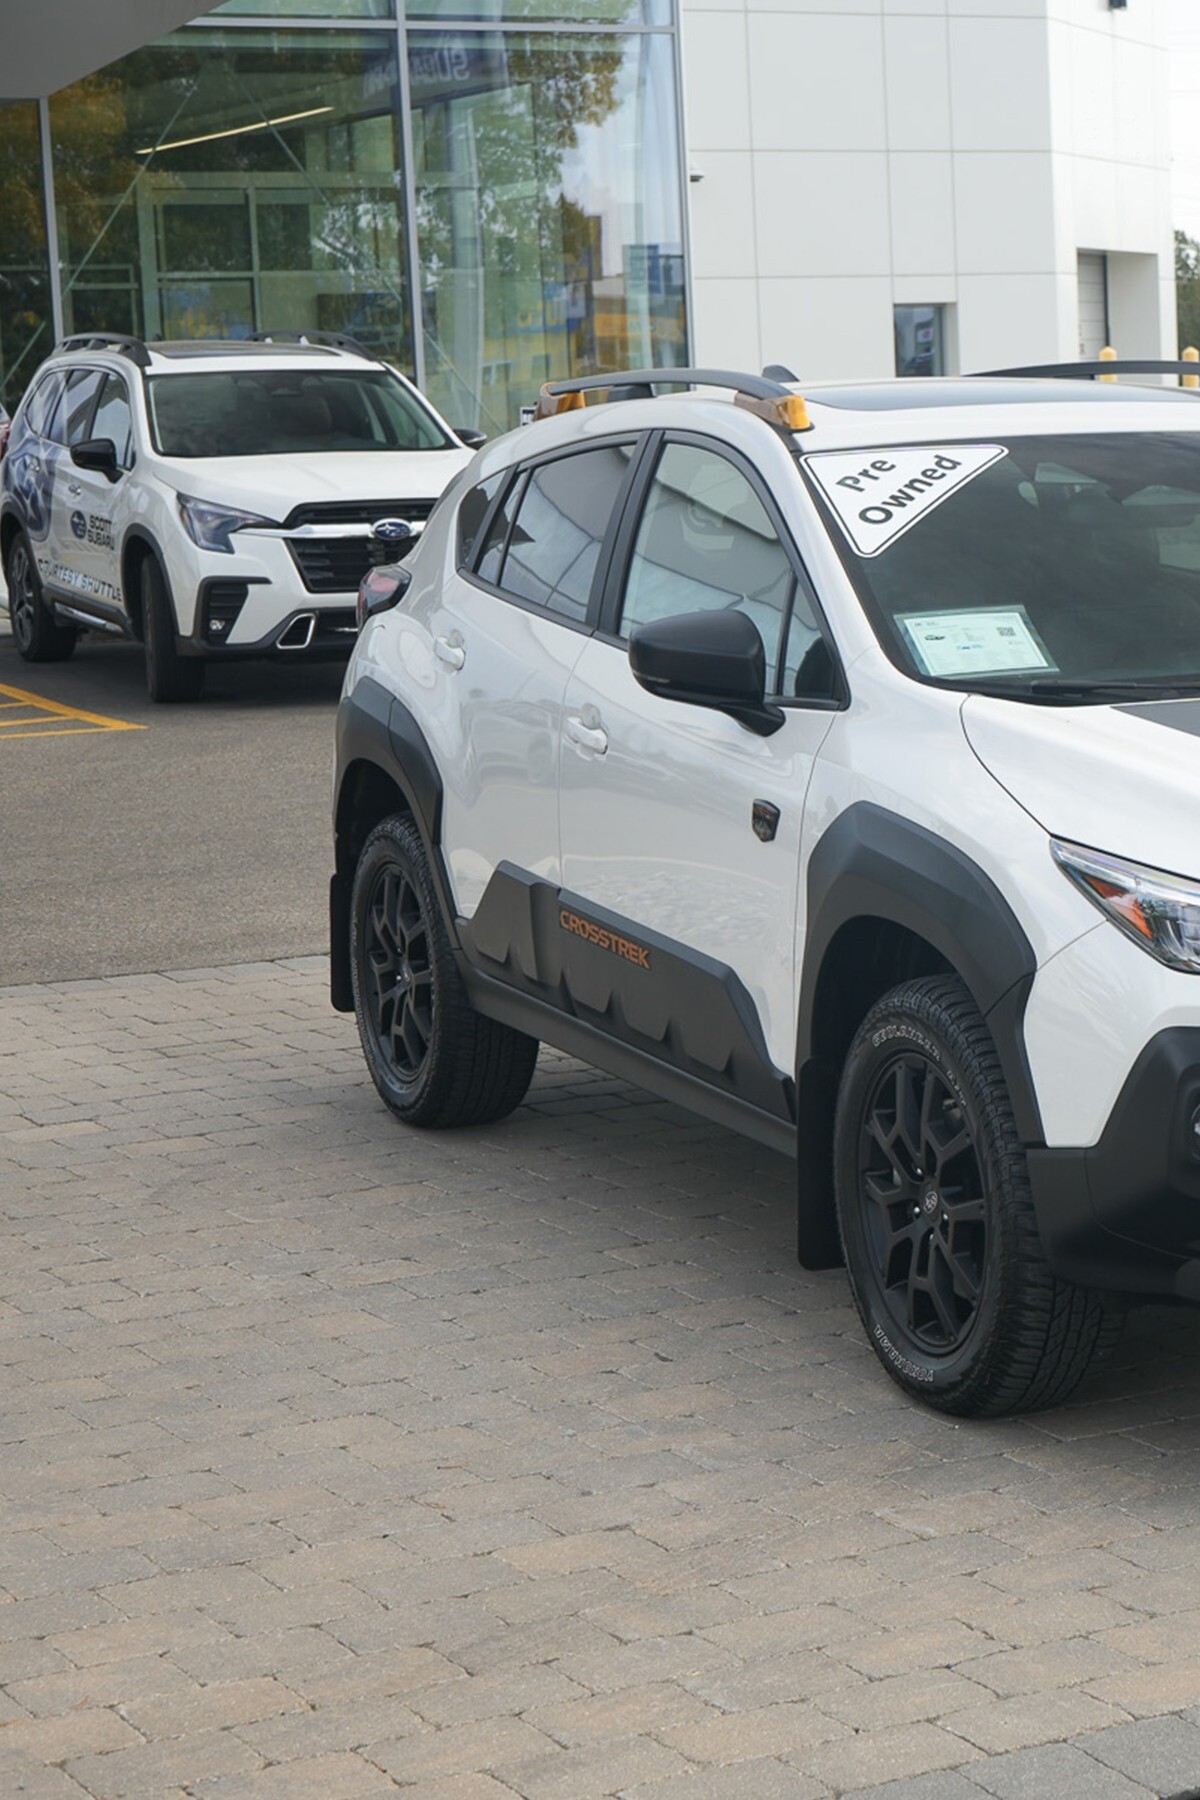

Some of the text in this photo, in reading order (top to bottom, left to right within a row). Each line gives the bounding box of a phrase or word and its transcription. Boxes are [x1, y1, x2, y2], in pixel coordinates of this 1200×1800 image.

[836, 459, 896, 492] Pre
[858, 454, 962, 525] Owned
[87, 529, 115, 550] SUBARU
[89, 515, 112, 534] SCOTT
[81, 574, 122, 602] SHUTTLE
[560, 910, 651, 969] CROSSTREK
